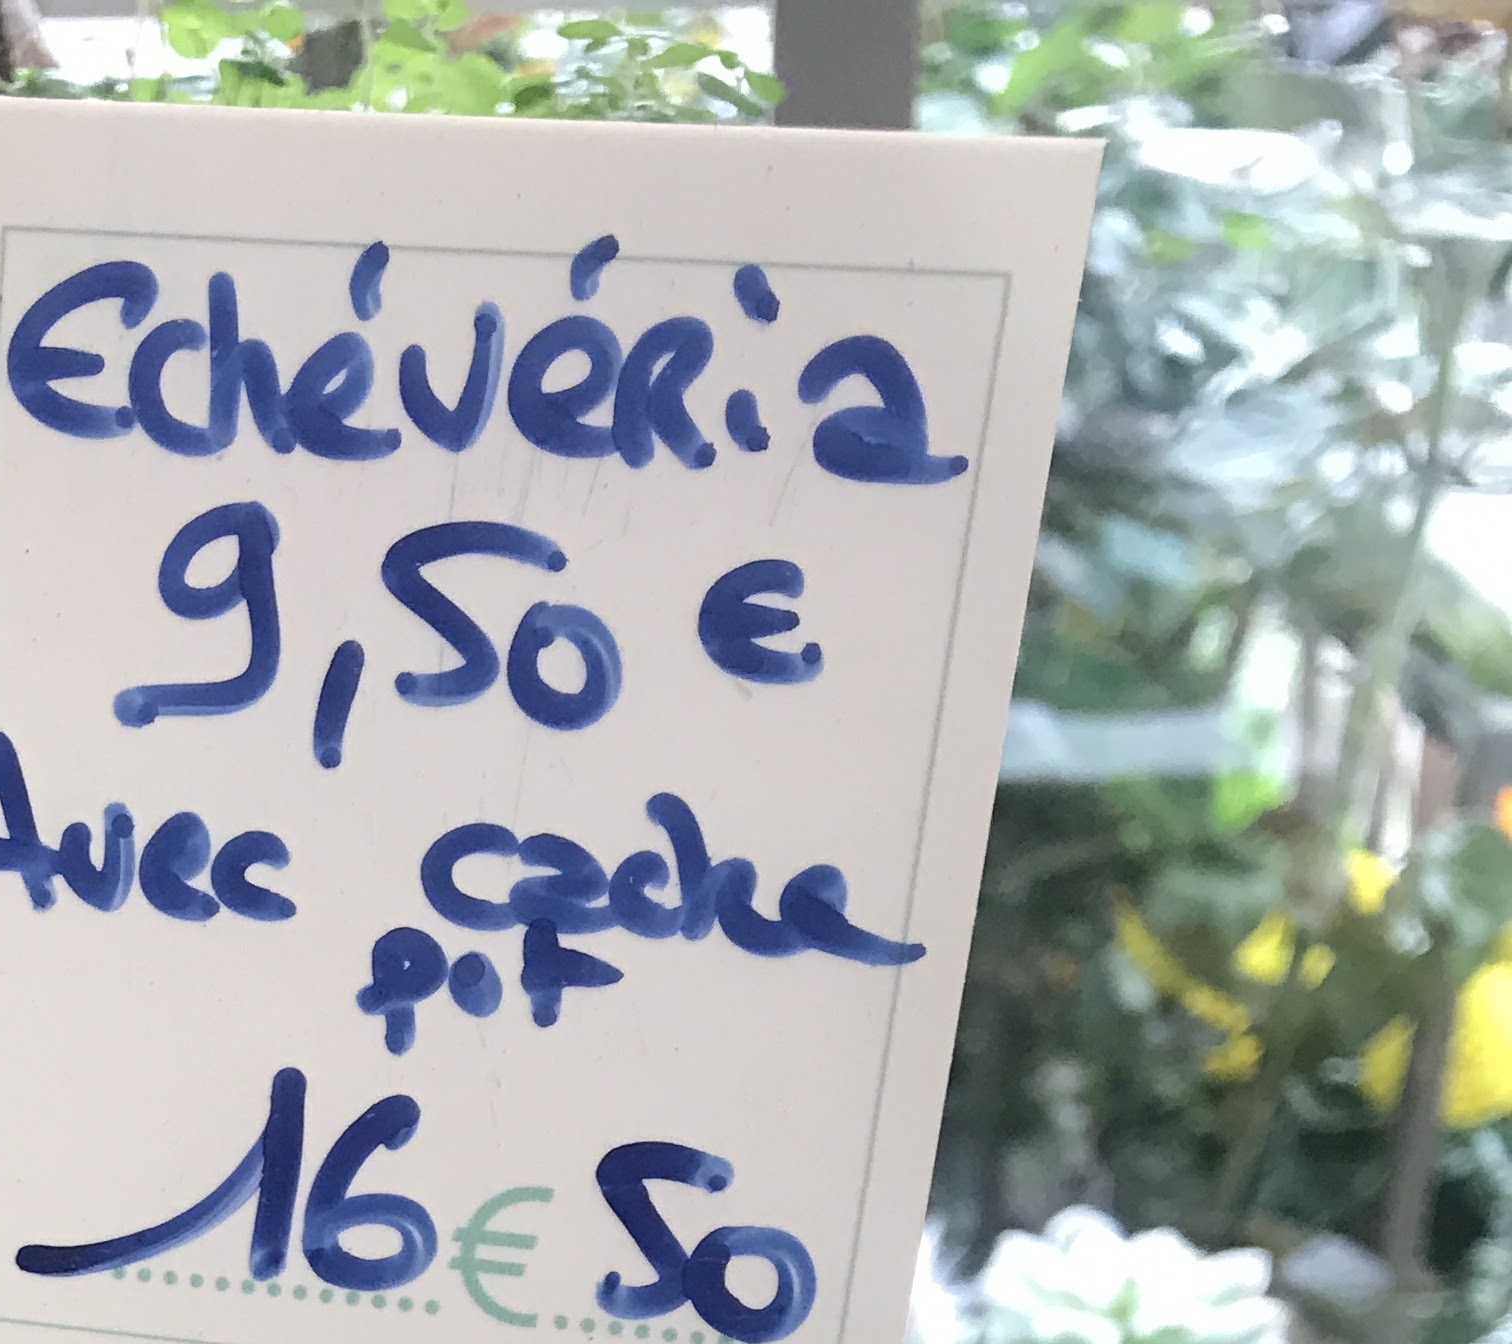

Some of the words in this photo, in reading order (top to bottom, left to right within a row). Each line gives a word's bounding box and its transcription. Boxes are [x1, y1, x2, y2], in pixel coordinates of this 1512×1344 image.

[113, 501, 623, 770] 9,50
[697, 558, 823, 684] €
[419, 792, 927, 968] cache
[14, 1067, 439, 1292] 16
[448, 1186, 555, 1328] €
[595, 1140, 817, 1344] 50
